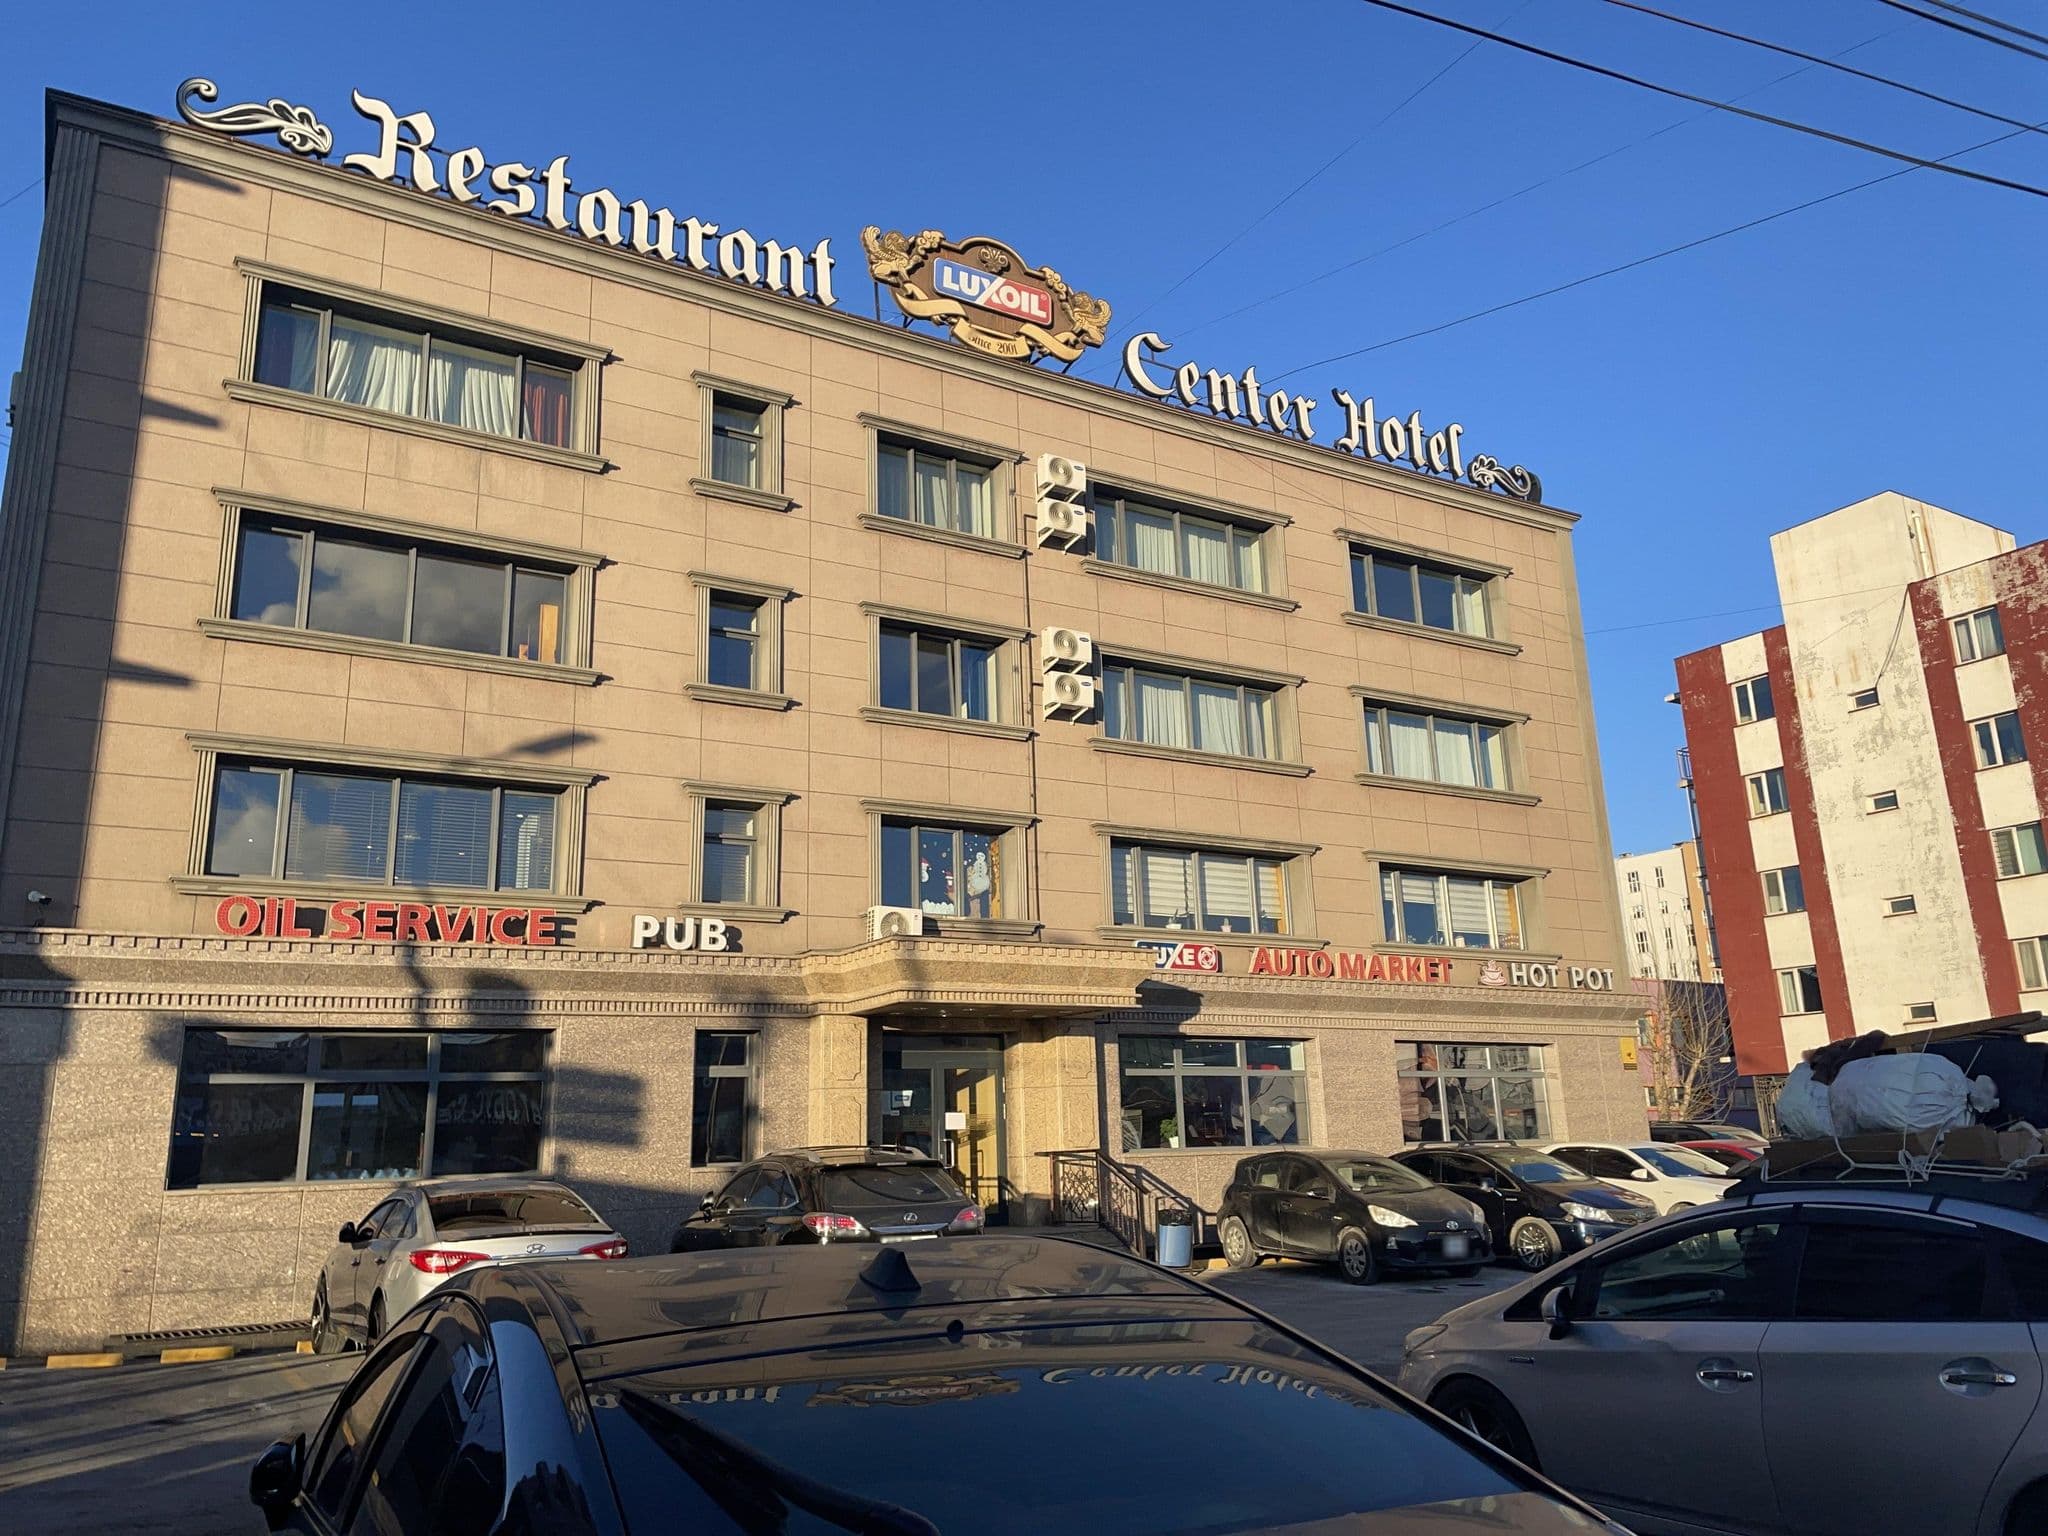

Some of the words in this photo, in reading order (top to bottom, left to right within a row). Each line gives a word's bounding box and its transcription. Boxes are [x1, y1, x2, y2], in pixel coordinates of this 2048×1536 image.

[342, 88, 838, 307] Restaurant
[943, 266, 1047, 318] LUXOIL
[997, 342, 1018, 355] 2001
[1123, 332, 1317, 441] Center
[1331, 388, 1466, 480] Hotel
[214, 895, 311, 939] OIL
[328, 899, 557, 946] SERVICE
[631, 913, 729, 952] PUB
[1249, 946, 1333, 980] AUTO
[1334, 951, 1454, 984] MARKET
[1508, 962, 1560, 989] HOT
[1569, 964, 1615, 991] POT
